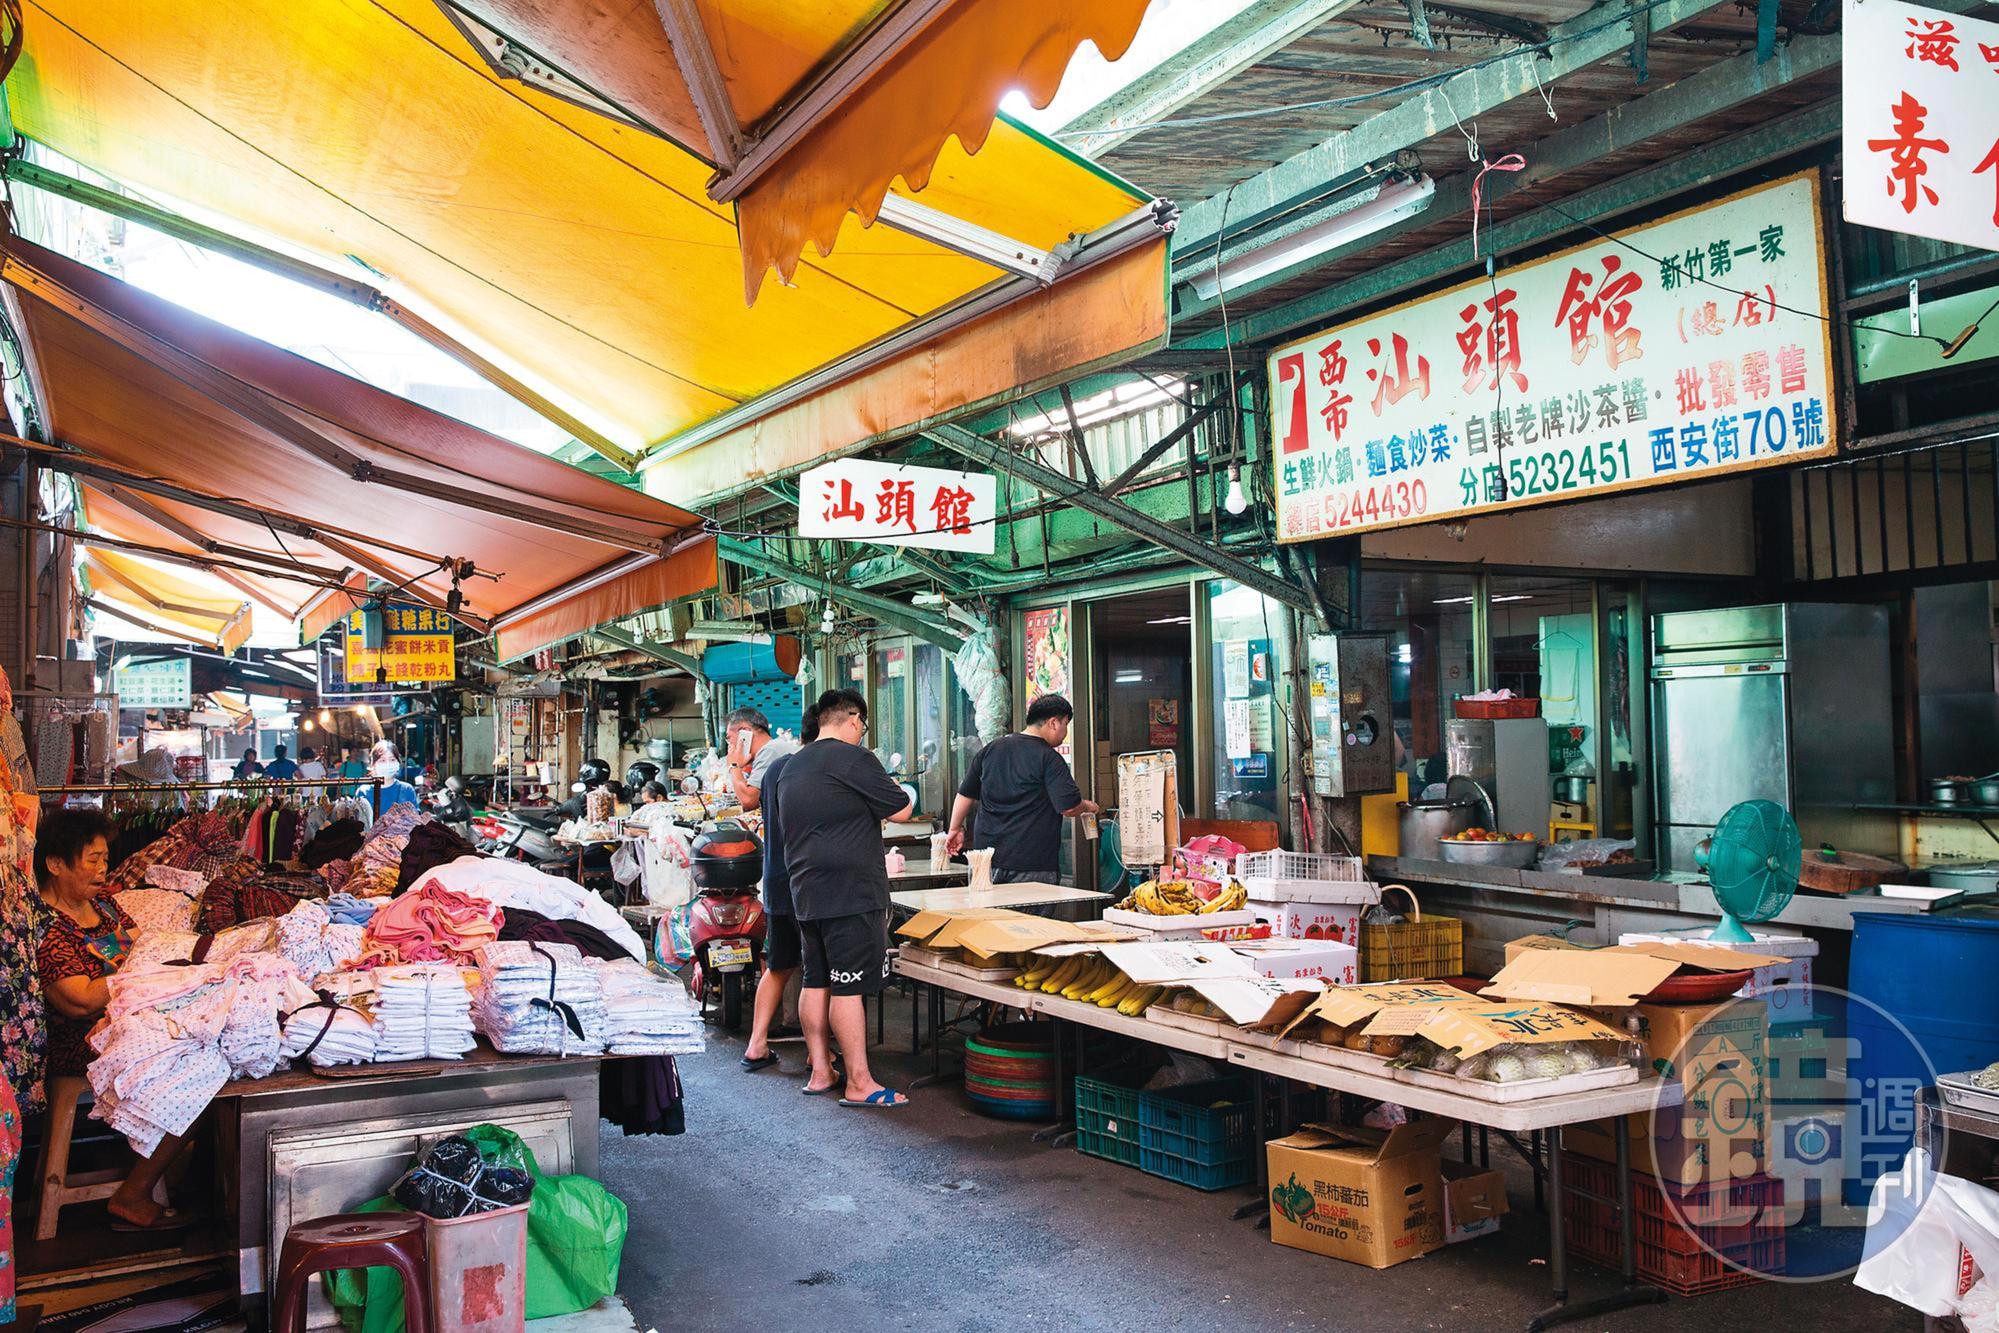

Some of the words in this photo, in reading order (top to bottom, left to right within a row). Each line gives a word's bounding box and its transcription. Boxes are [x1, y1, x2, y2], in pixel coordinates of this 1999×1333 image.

[1660, 224, 1786, 291] 新竹第一家
[1366, 255, 1644, 417] 汕頭館
[1283, 446, 1354, 496] 生鮮火鍋
[1365, 424, 1451, 478] 麵食炒菜
[1465, 377, 1648, 456] 自製老牌沙茶醬
[1674, 344, 1807, 416] 批發零售
[1318, 339, 1353, 442] 西市
[1510, 438, 1631, 498] 5232451
[1648, 397, 1825, 474] 西安街70號
[822, 478, 976, 536] 汕頭館
[1324, 478, 1428, 528] 5244430
[1693, 1062, 1709, 1165] 分級包裝
[1313, 1179, 1369, 1208] 黑柿蕃茄
[1299, 1217, 1348, 1241] Tomato
